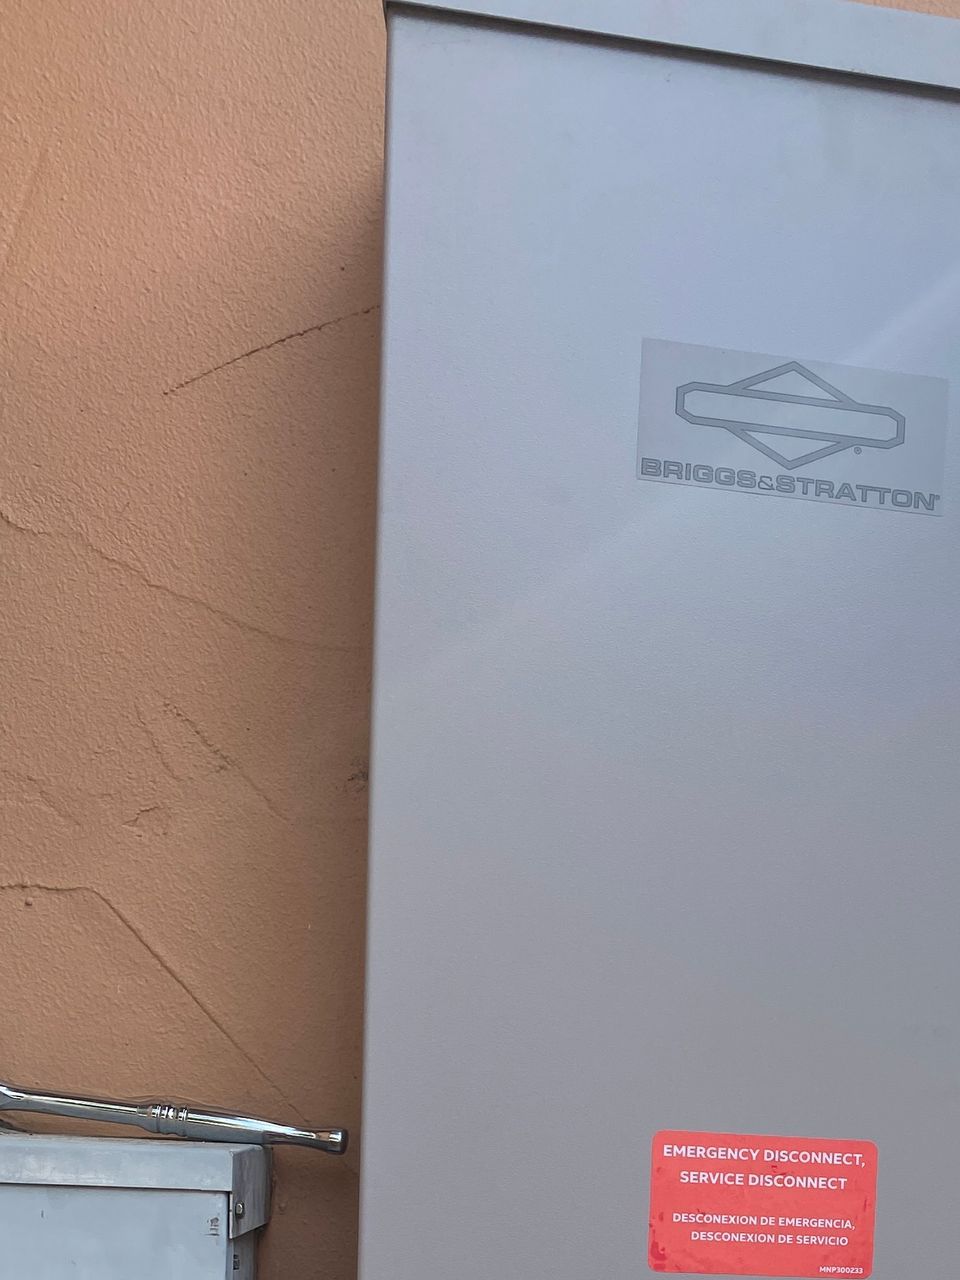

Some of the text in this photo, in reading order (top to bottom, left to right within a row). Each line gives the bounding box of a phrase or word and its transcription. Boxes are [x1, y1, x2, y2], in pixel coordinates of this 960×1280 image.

[663, 1144, 866, 1168] EMERGENCY DISCONNECT,
[680, 1170, 847, 1190] SERVICE DISCONNECT
[672, 1212, 856, 1230] DESCONEXION DE EMERGENCIA,
[691, 1231, 848, 1246] DESCONEXION DE SERVICIO
